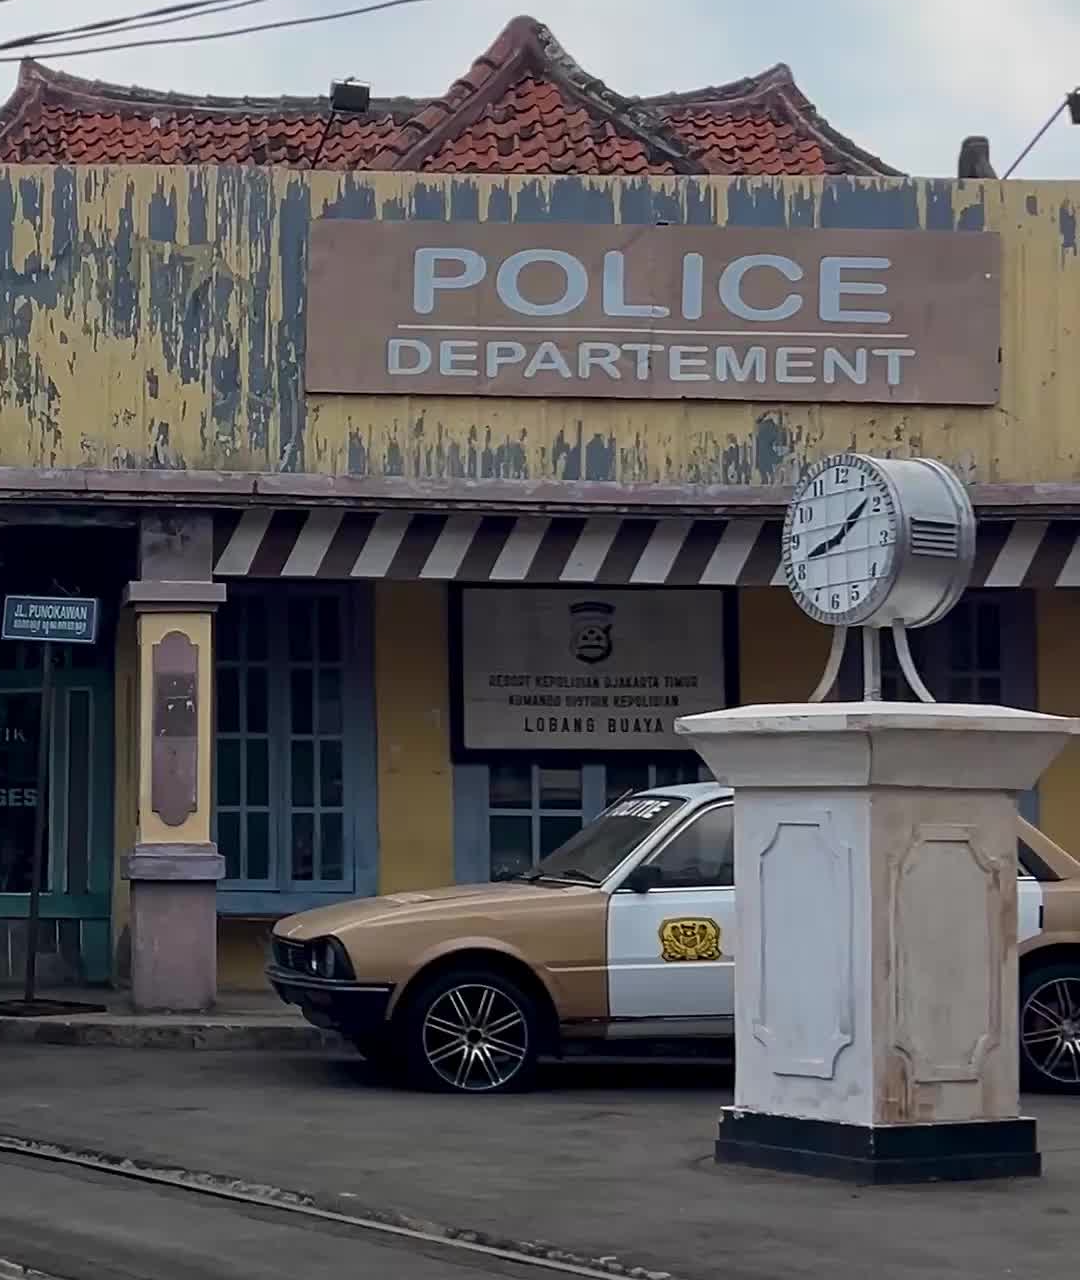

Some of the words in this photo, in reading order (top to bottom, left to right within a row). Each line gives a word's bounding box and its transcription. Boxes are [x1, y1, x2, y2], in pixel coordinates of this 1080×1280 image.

[412, 246, 892, 323] POLICE
[386, 337, 916, 385] DEPARTEMENT
[835, 468, 849, 484] 12
[859, 475, 865, 491] 1
[813, 479, 824, 497] 11
[872, 496, 881, 513] 2
[799, 507, 813, 523] 10
[792, 533, 801, 550] 9
[879, 530, 889, 547] 3
[798, 564, 806, 580] 8
[869, 562, 878, 578] 4
[814, 587, 822, 602] 7
[831, 593, 840, 609] 6
[851, 585, 860, 601] 5
[28, 604, 88, 620] PUNOKAWAN
[524, 716, 595, 733] LOBANG
[608, 716, 665, 733] BUAYA
